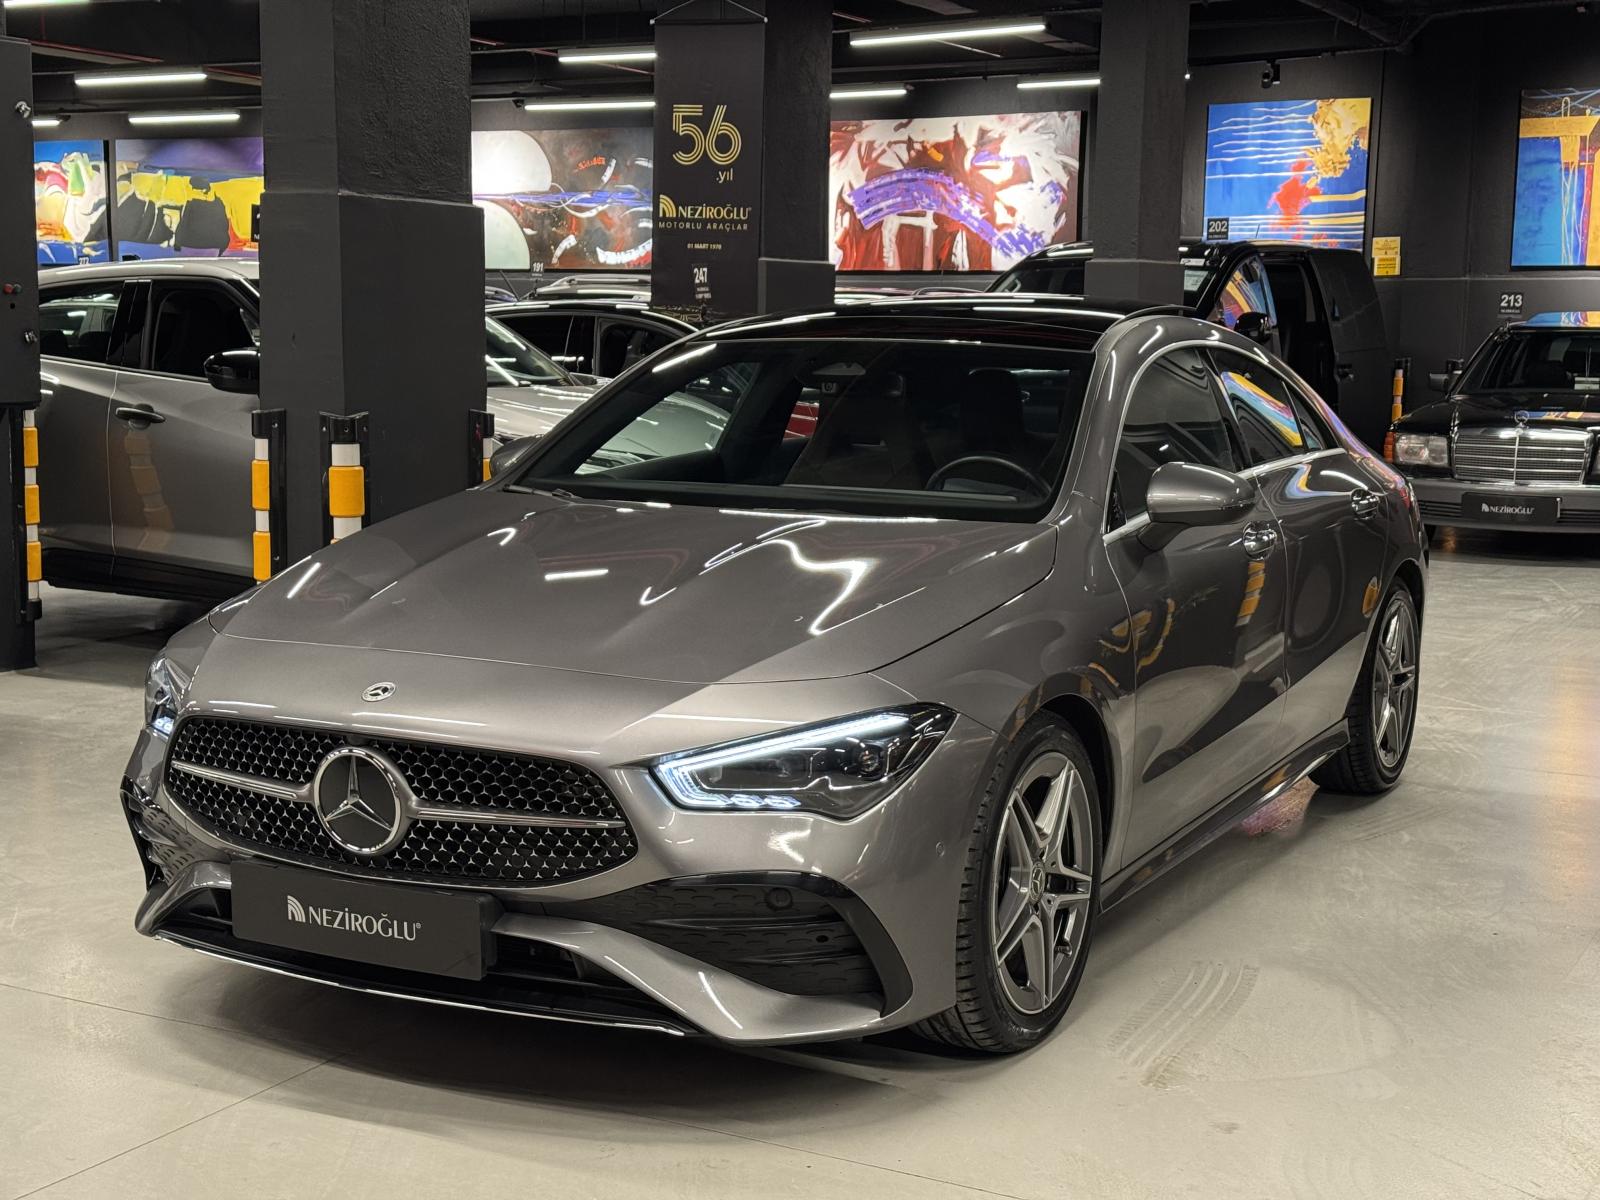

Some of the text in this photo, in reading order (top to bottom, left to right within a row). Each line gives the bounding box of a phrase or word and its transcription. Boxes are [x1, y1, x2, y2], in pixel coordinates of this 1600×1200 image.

[672, 104, 742, 165] 56
[678, 203, 750, 220] NEZİROĞLU
[659, 221, 748, 232] MOTORLU ARAÇLAR
[1208, 220, 1228, 232] 202
[532, 262, 544, 272] 191
[693, 267, 708, 283] 247
[1500, 294, 1523, 307] 213
[308, 906, 416, 941] NEZİROĞLU
